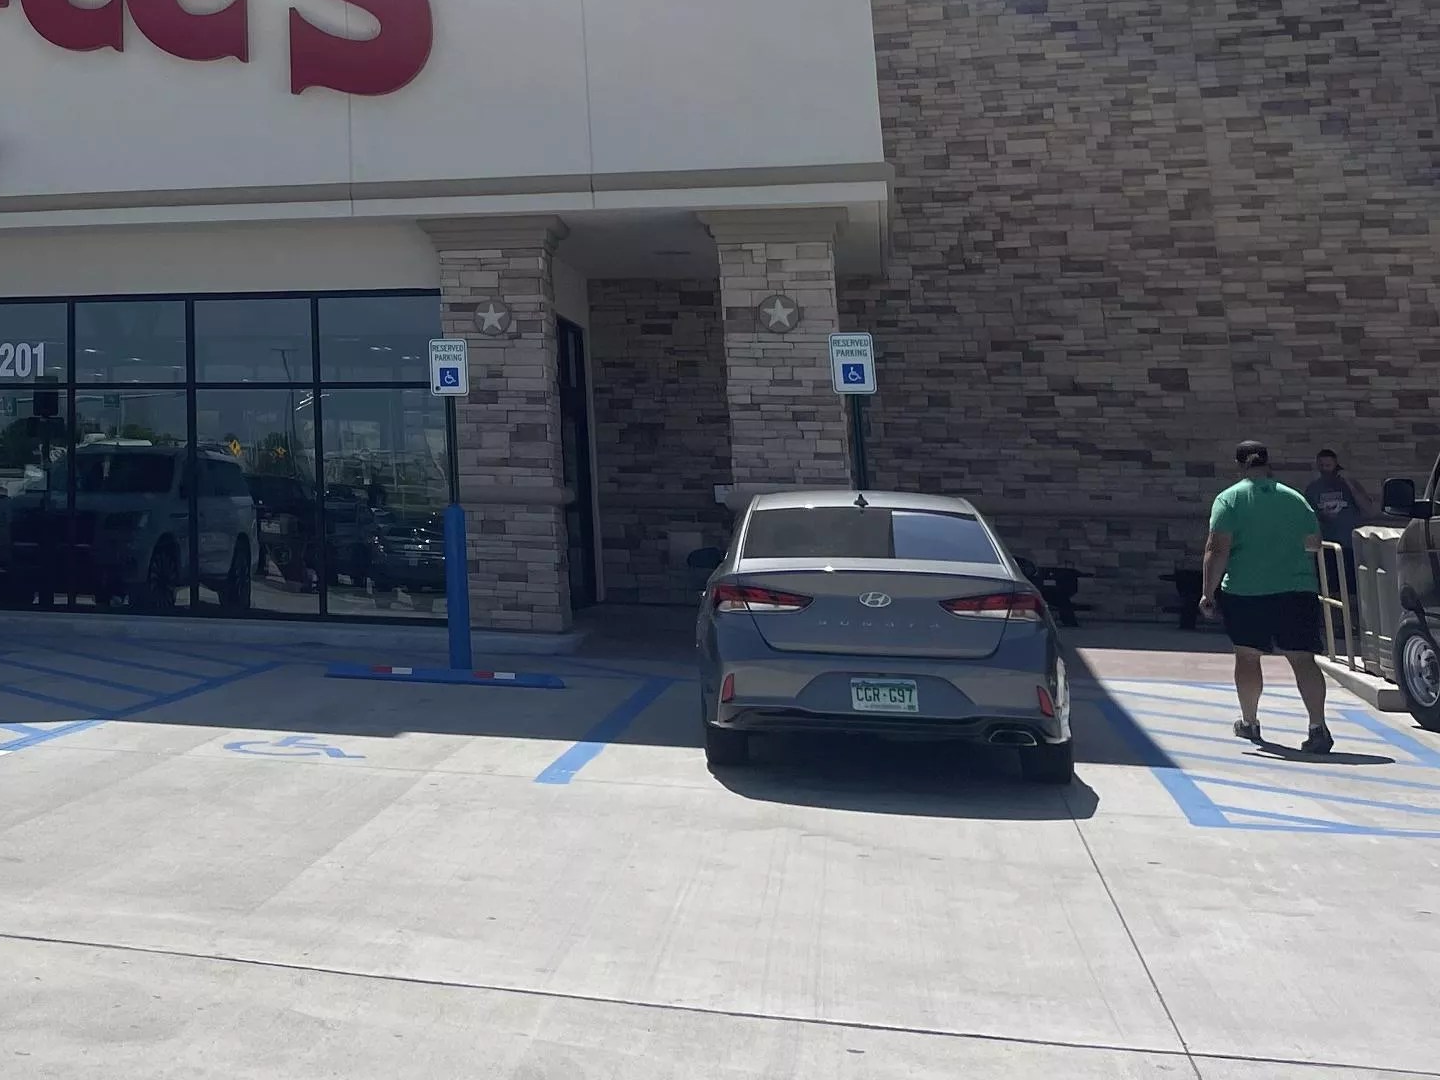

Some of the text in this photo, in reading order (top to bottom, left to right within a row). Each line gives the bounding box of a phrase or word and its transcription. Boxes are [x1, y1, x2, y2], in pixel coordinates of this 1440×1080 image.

[832, 339, 869, 347] RESERVED
[431, 344, 464, 352] RESERVED
[836, 349, 868, 357] PARKING
